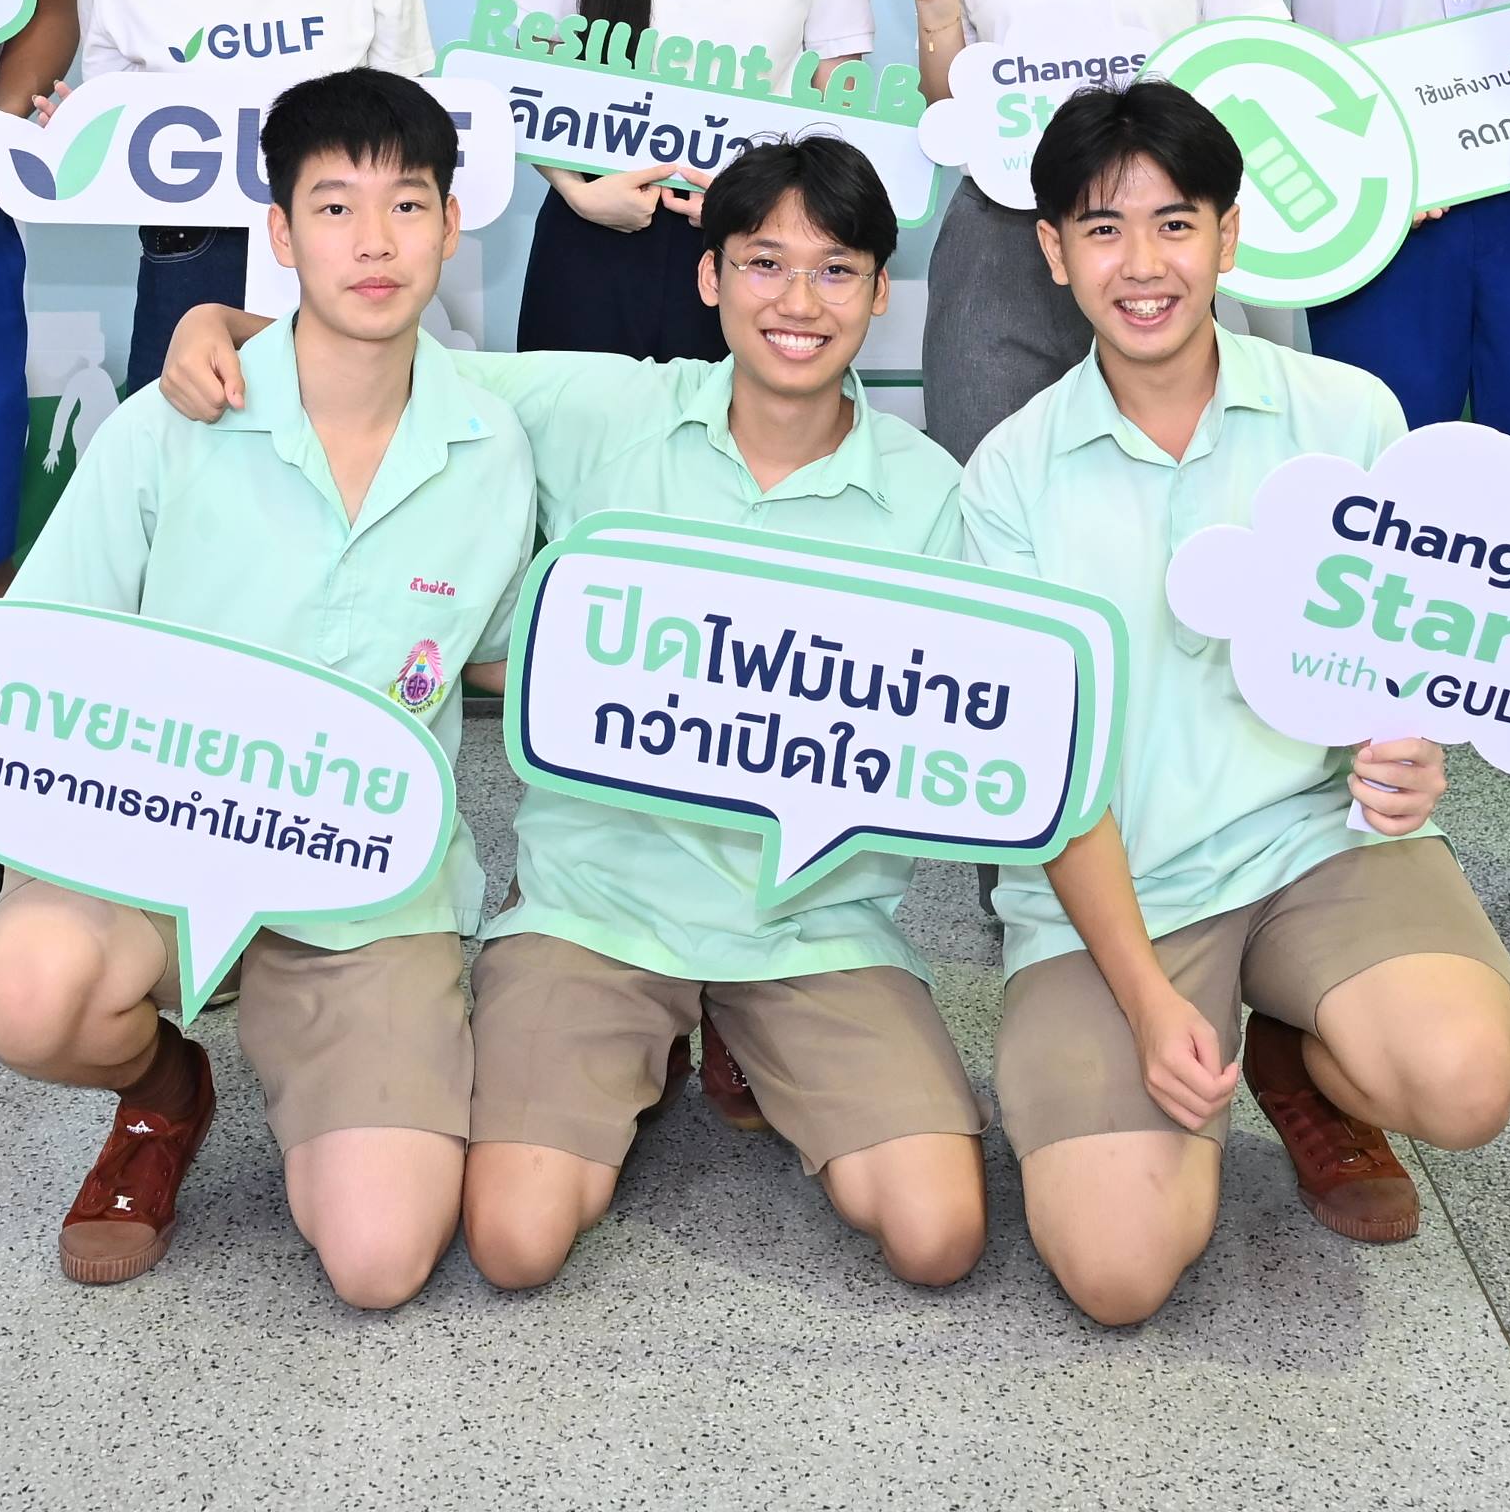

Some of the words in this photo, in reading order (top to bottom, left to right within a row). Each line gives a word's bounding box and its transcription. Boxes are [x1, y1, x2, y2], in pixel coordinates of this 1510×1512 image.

[207, 16, 325, 60] GULF
[792, 49, 928, 125] LAB
[583, 584, 1010, 731] ปิดไฟมันง่าย
[1291, 651, 1377, 692] with
[594, 694, 1027, 816] กว่าเปิดใจเธอ
